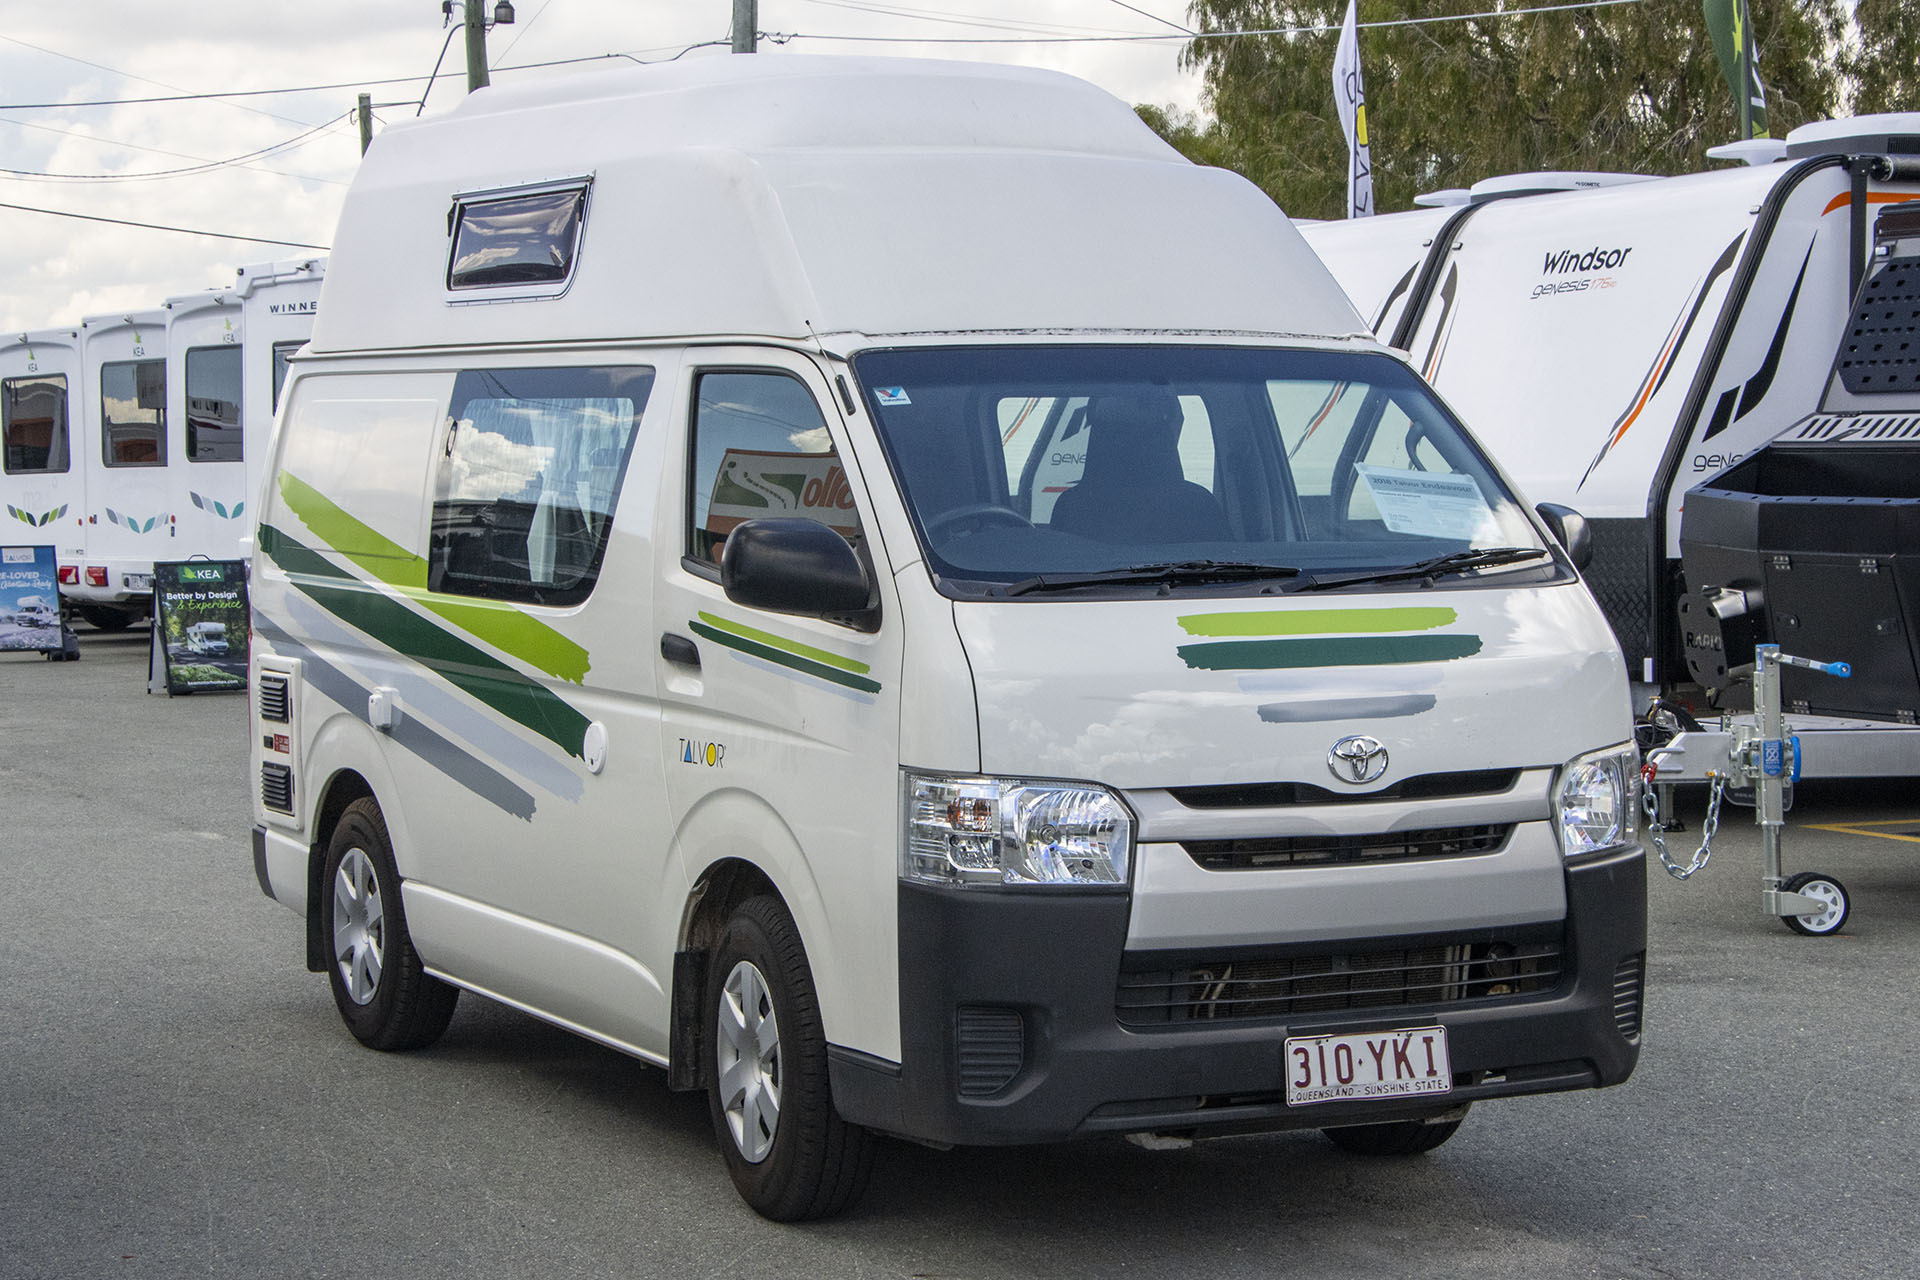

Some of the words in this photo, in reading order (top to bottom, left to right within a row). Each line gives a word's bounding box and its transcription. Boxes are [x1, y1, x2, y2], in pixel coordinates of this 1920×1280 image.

[1543, 246, 1632, 275] Windsor
[133, 346, 145, 357] KEA
[28, 363, 38, 372] KEA
[0, 571, 40, 579] E-LOVED
[197, 569, 221, 579] KEA
[166, 592, 193, 600] Better
[195, 591, 206, 600] by
[208, 591, 238, 600] Design
[177, 599, 185, 609] &
[188, 599, 243, 614] Experience
[679, 738, 725, 769] TALVOR
[1295, 1087, 1354, 1101] QUEENSLAND
[1364, 1083, 1410, 1096] SUNSHINE
[1415, 1079, 1443, 1090] STATE
